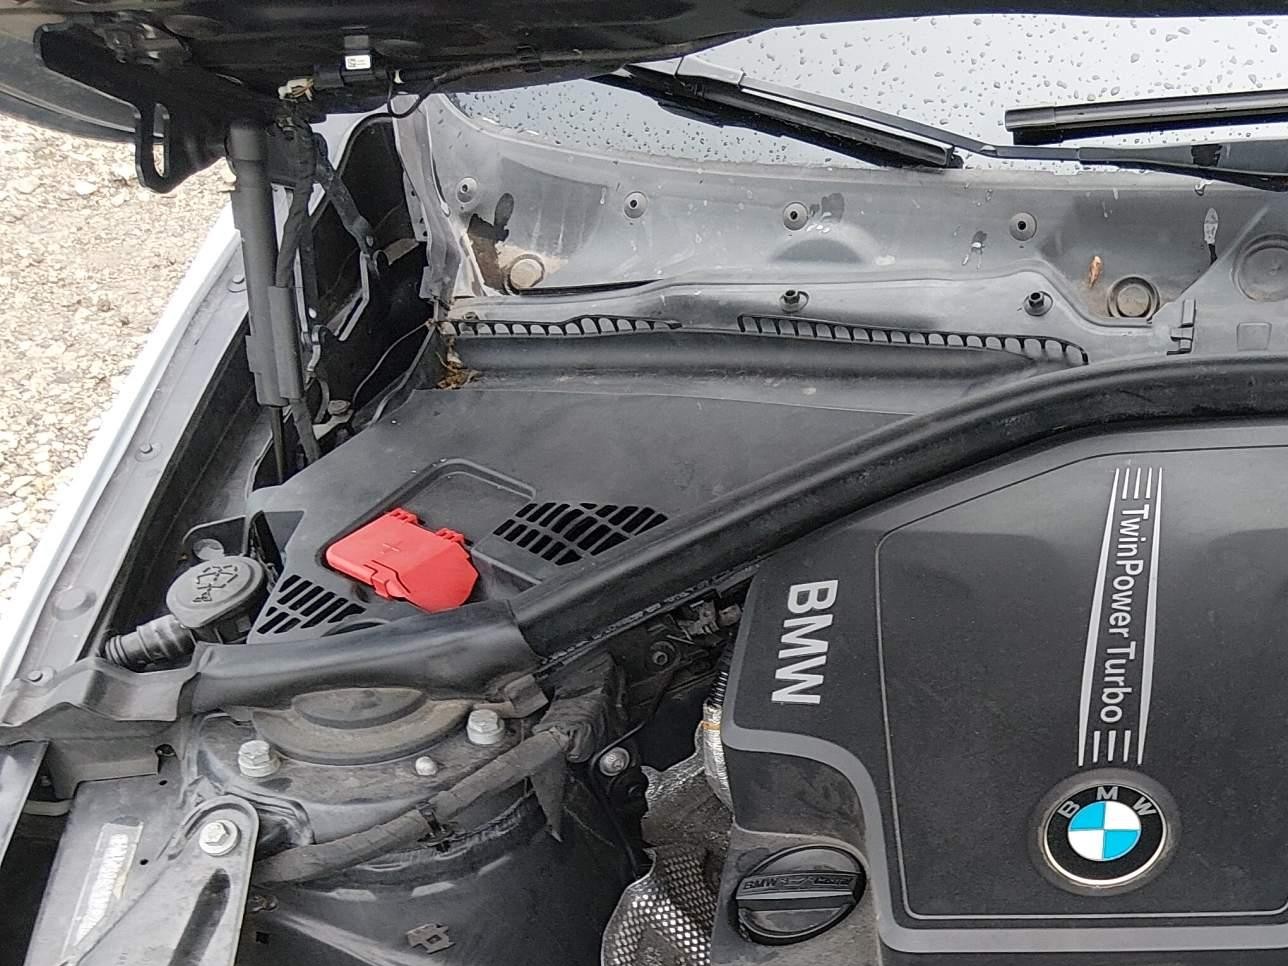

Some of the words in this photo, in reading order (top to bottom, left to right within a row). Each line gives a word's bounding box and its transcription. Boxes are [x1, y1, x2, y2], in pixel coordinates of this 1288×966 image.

[1108, 503, 1150, 638] TwinPower
[771, 579, 839, 705] BMW
[1100, 641, 1137, 724] Turbo
[1057, 785, 1157, 819] BMW
[743, 877, 777, 890] BMW
